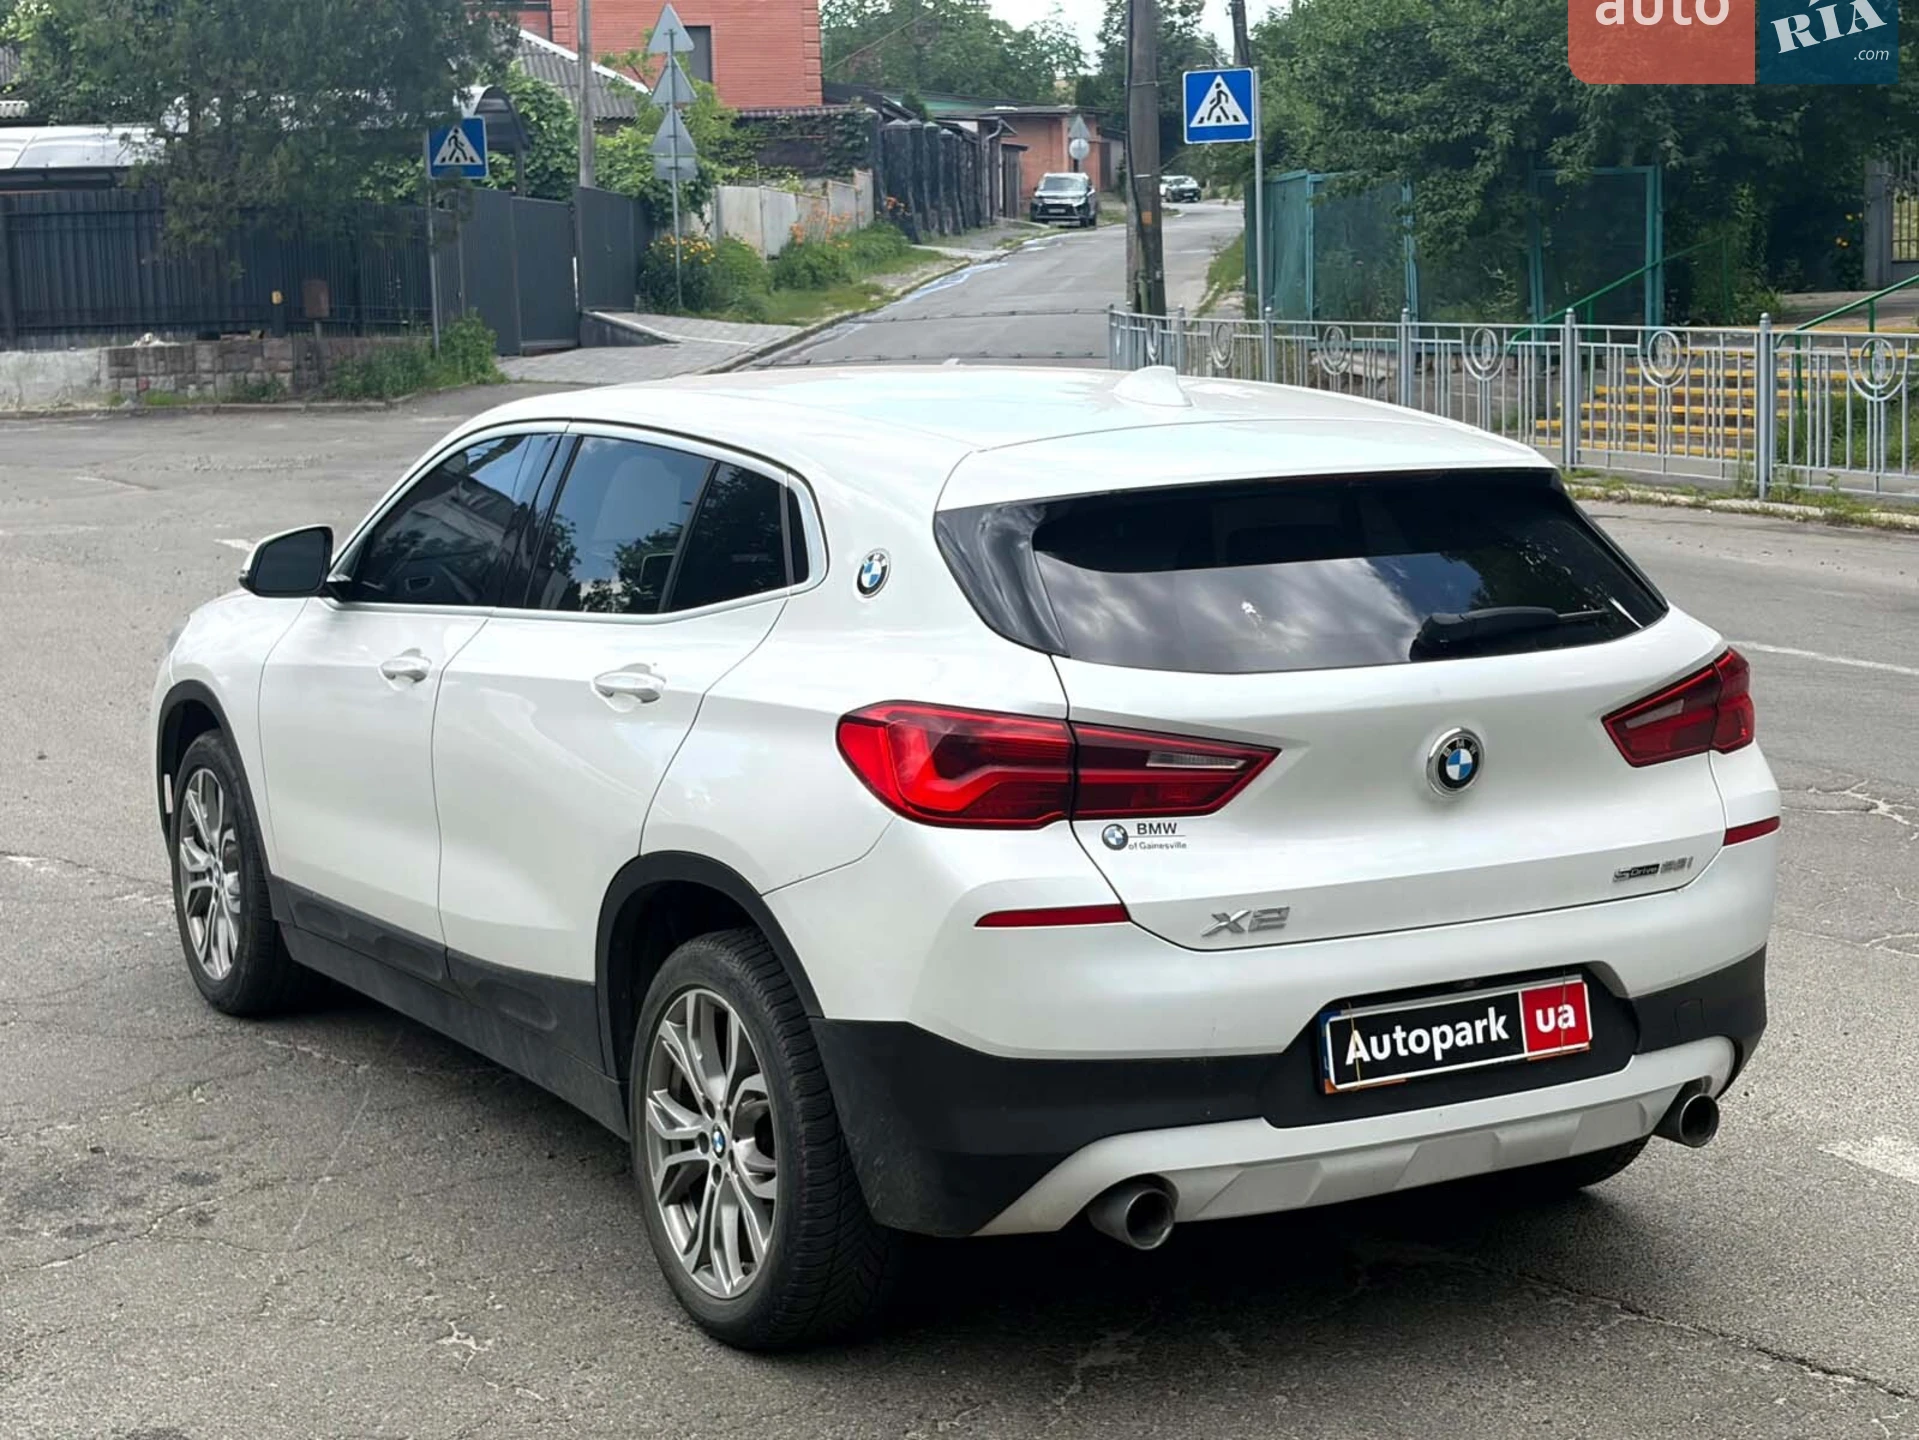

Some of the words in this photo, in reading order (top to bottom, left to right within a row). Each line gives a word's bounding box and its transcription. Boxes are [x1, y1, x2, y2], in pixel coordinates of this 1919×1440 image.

[1137, 822, 1177, 835] BMW
[1128, 842, 1138, 850] of
[1139, 841, 1187, 850] Gainesville
[1201, 906, 1290, 937] X2
[1345, 1006, 1509, 1066] Autopark
[1535, 1003, 1576, 1033] ua
